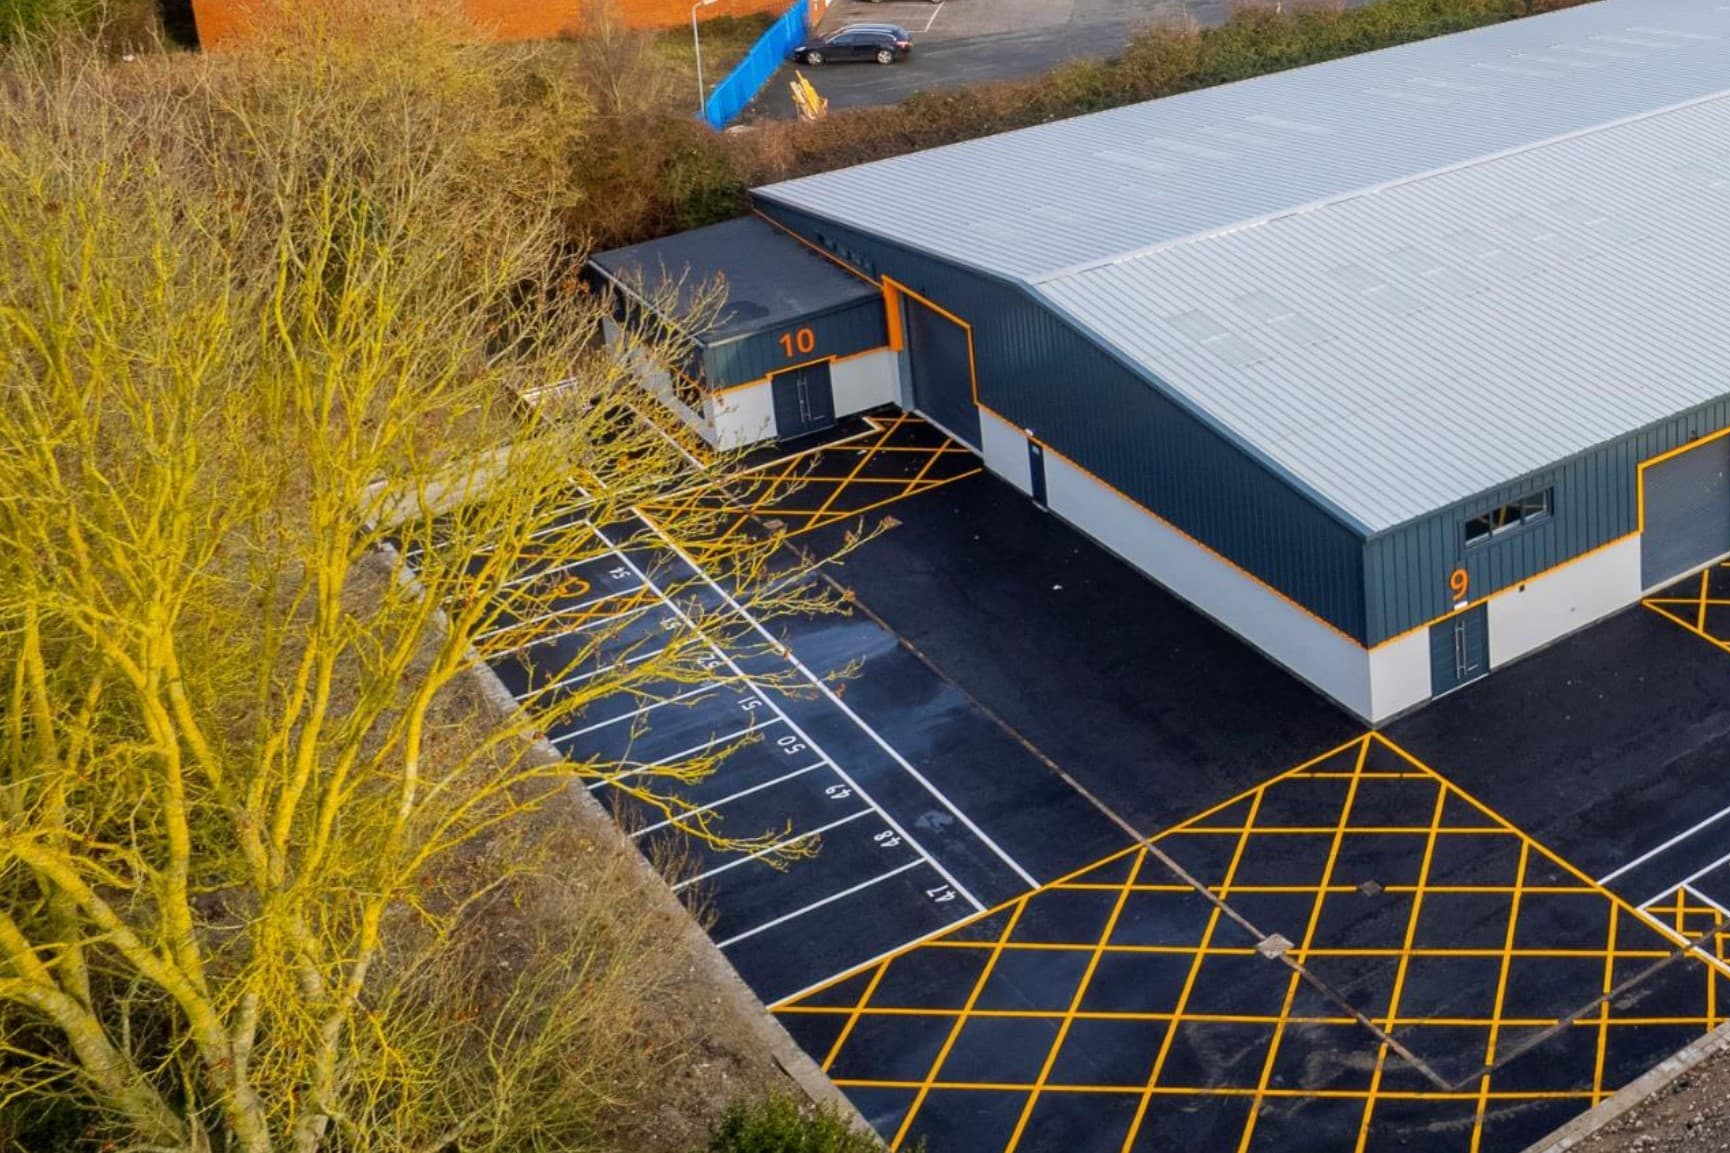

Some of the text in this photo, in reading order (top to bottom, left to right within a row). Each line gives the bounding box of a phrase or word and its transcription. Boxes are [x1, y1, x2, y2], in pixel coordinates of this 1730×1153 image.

[779, 328, 815, 358] 10
[608, 566, 631, 580] 54
[1450, 568, 1468, 600] 9
[737, 696, 763, 712] 51
[776, 735, 807, 755] 50
[825, 784, 852, 799] 49
[873, 829, 901, 848] 48
[926, 884, 957, 903] 47
